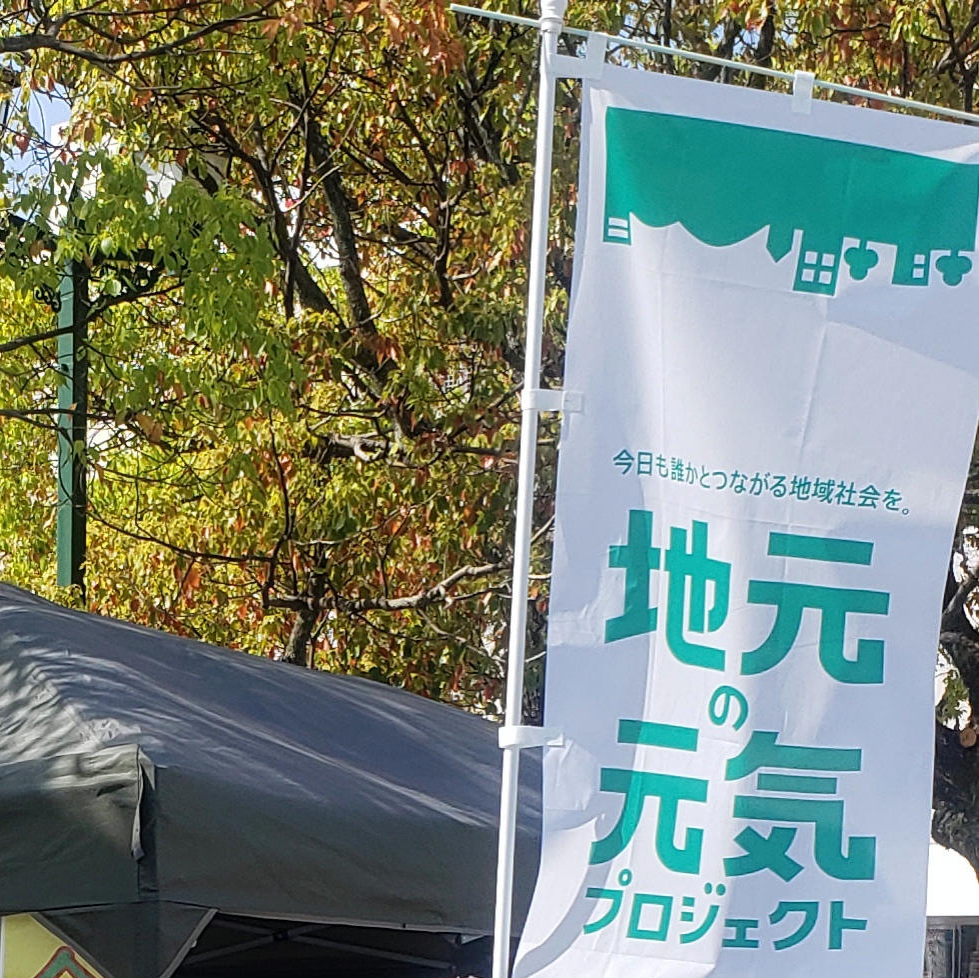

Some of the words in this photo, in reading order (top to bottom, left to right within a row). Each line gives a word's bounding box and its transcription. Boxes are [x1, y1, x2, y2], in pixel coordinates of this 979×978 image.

[612, 449, 910, 516] 今日も誰かとつながる地域社会を。
[604, 509, 890, 684] 地元
[708, 685, 749, 732] の
[589, 718, 877, 883] 元気
[583, 869, 868, 951] プロジェクト
